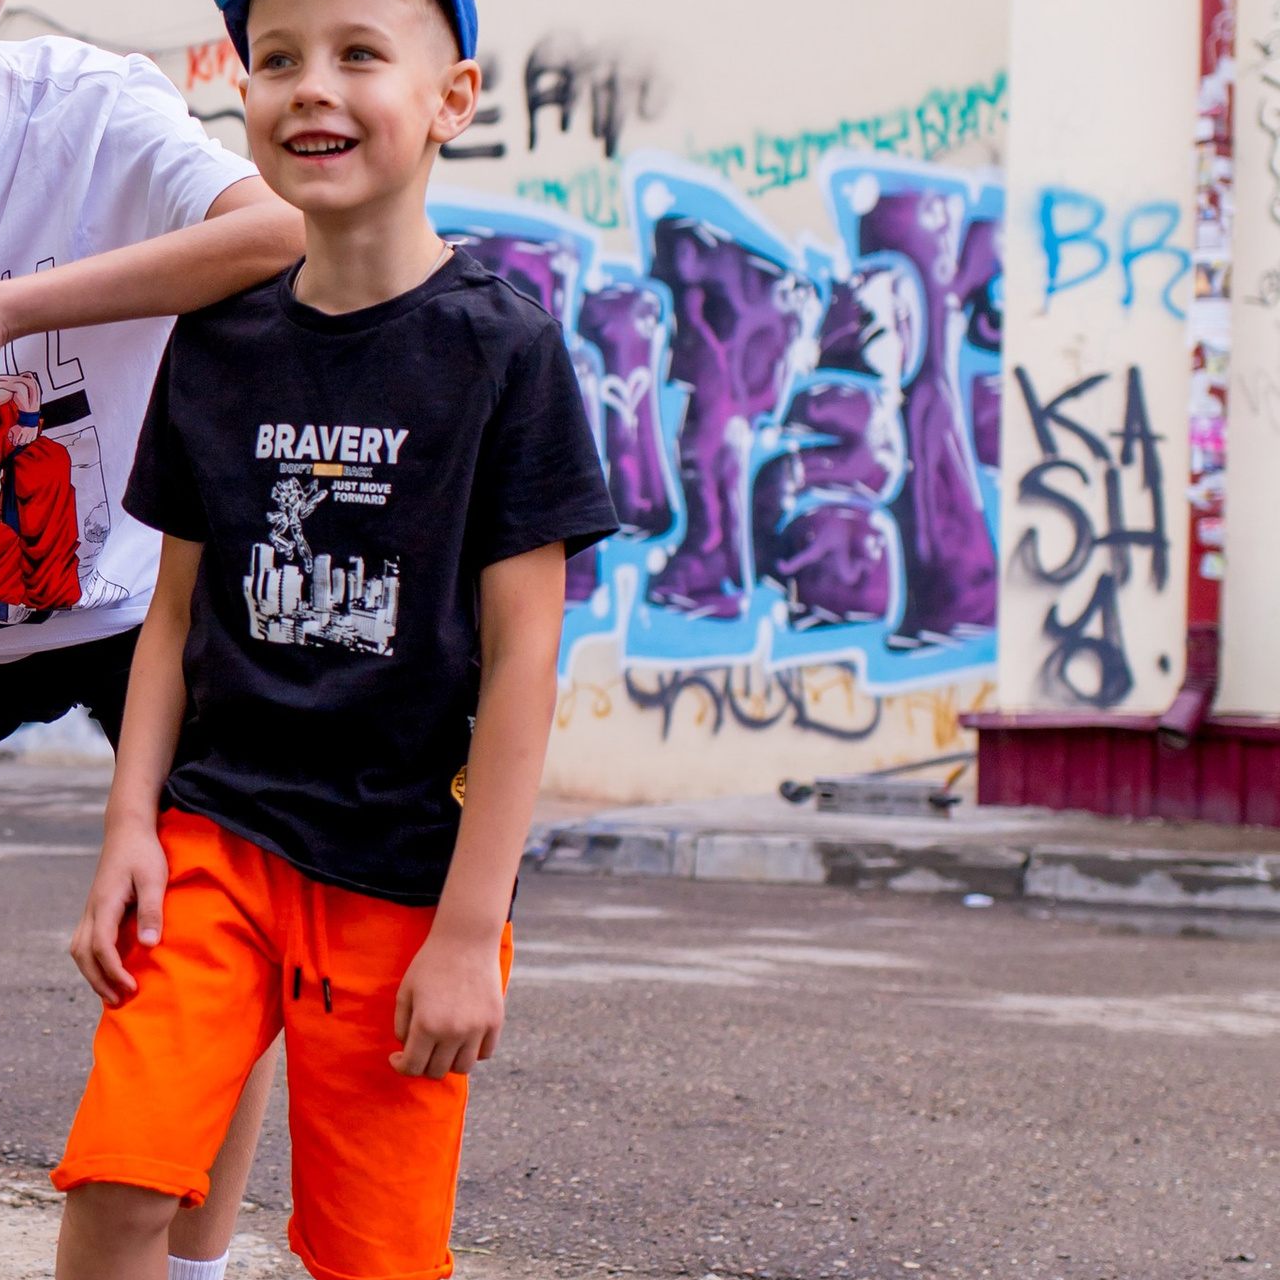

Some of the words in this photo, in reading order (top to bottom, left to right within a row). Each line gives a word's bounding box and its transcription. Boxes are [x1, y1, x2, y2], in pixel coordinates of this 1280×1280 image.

[255, 423, 410, 465] BRAVERY
[343, 465, 374, 478] BACK
[331, 480, 358, 492] JUST
[359, 482, 392, 494] MOVE
[333, 491, 387, 505] FORWARD
